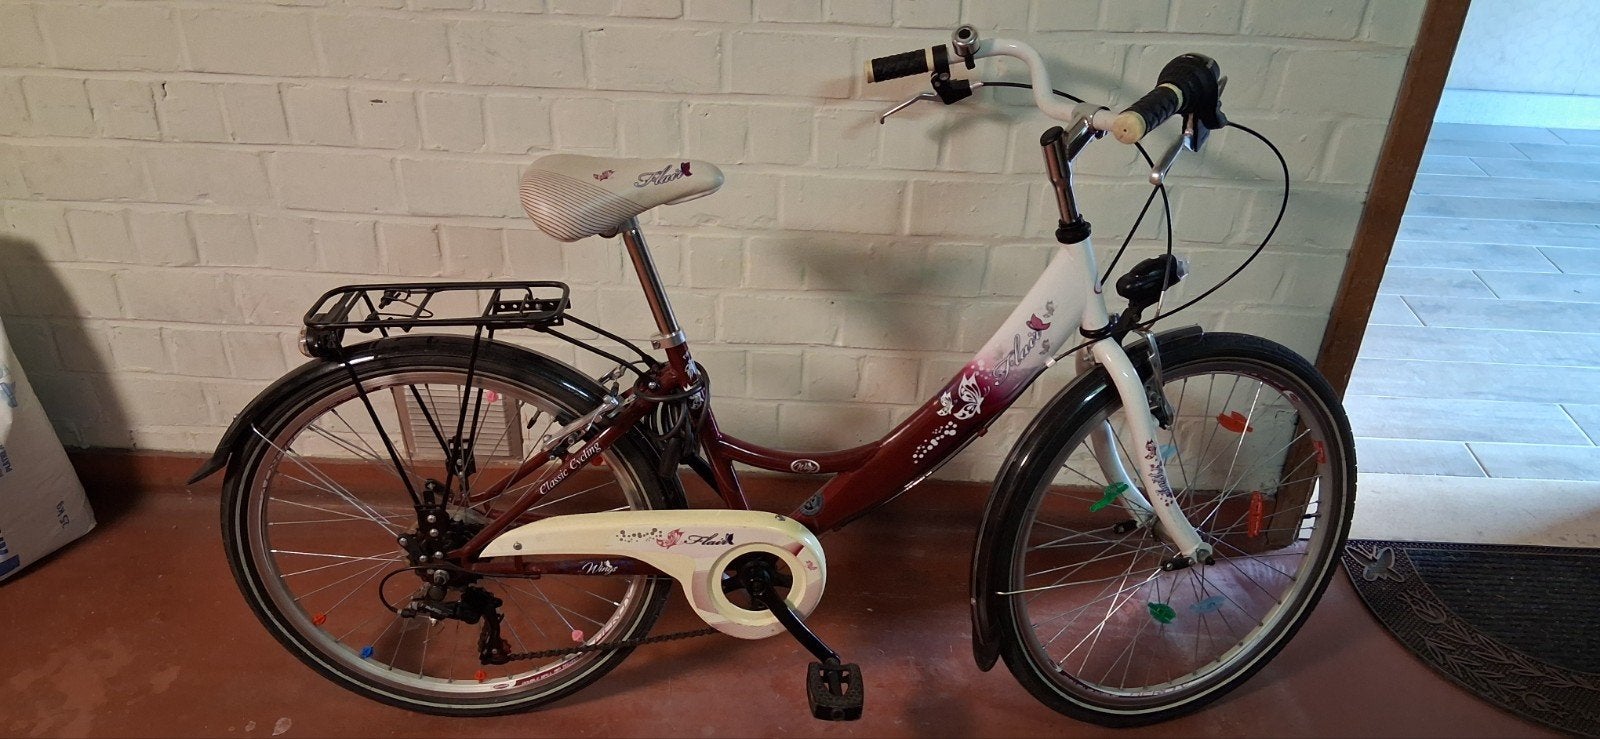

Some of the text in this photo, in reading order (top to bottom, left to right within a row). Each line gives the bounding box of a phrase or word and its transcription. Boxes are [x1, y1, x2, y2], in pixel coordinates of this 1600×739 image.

[539, 442, 601, 495] Classic Cycling
[684, 533, 728, 546] Flair
[581, 560, 618, 575] Wings
